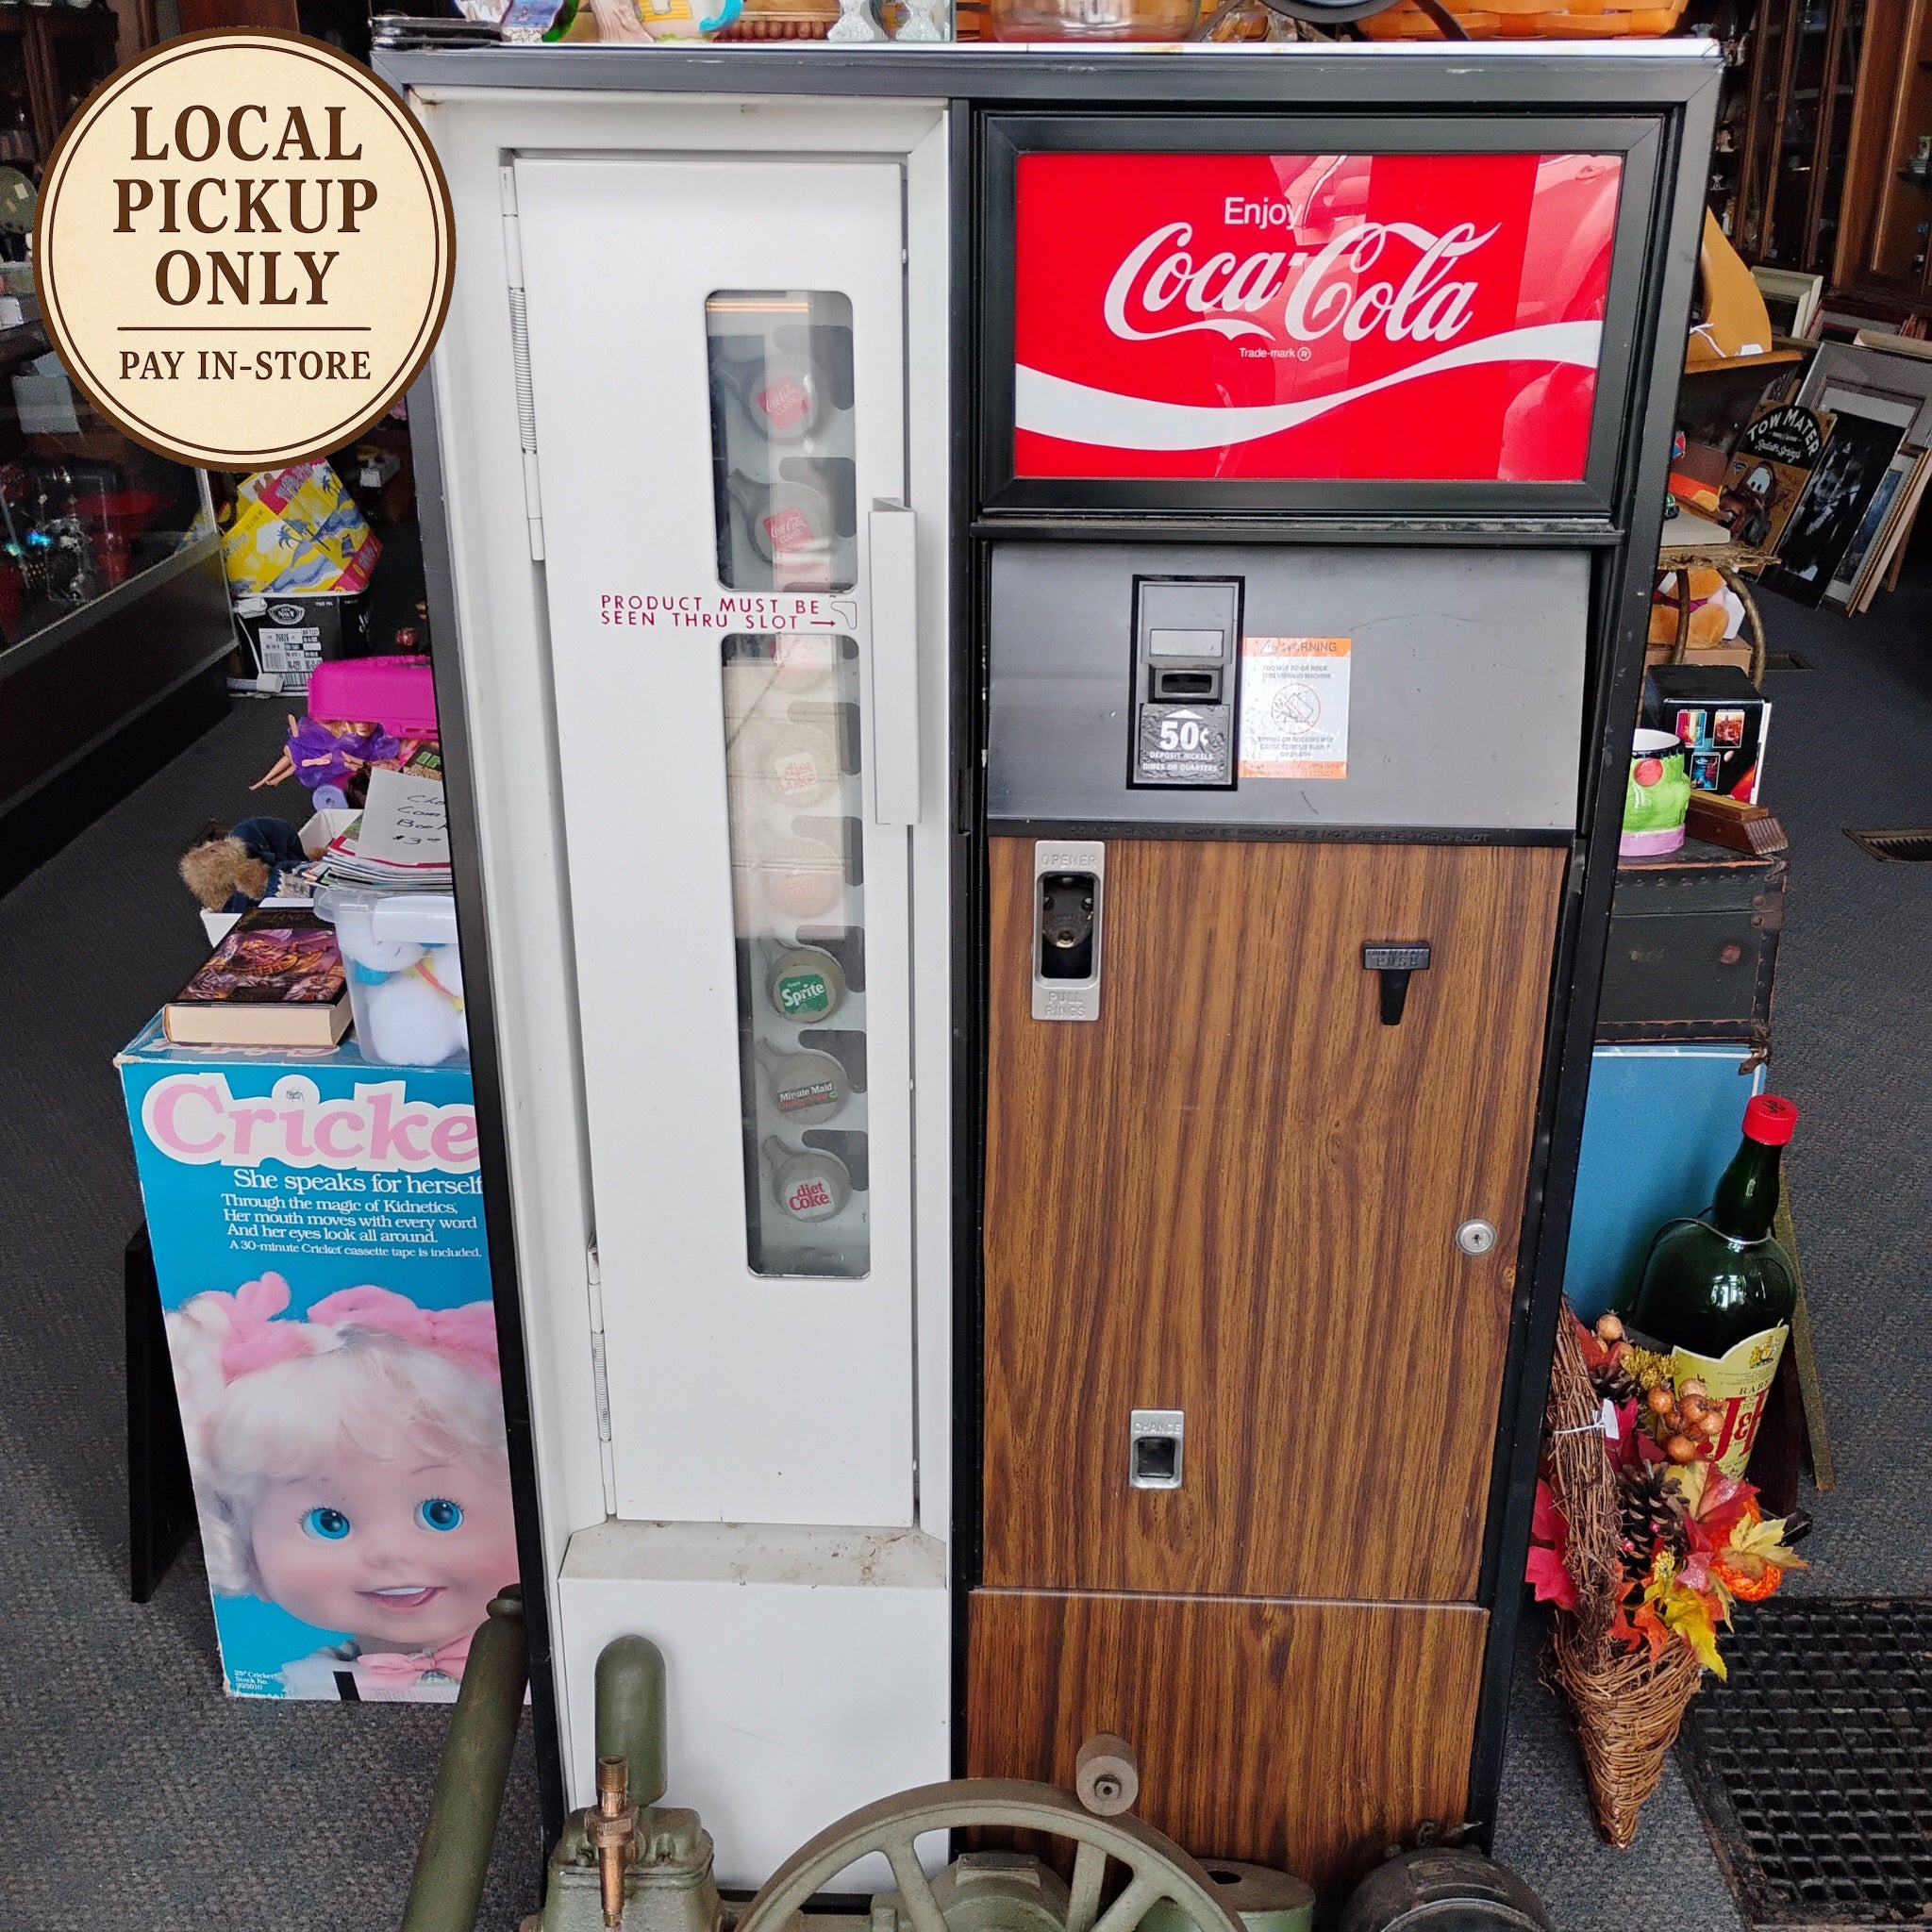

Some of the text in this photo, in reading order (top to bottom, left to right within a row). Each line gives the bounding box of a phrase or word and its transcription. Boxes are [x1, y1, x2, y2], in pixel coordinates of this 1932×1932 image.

[1224, 196, 1304, 230] Enjoy
[1104, 221, 1502, 341] Coca-Cola
[1747, 408, 1820, 458] TOW MATER
[601, 594, 819, 614] PRODUCT MUST BE
[601, 610, 798, 629] SEEN THRU SLOT
[1159, 721, 1209, 751] 50¢
[1149, 751, 1181, 759] DEPOSIT
[1179, 763, 1218, 773] QUARTERS
[1322, 830, 1349, 839] NOT
[1355, 830, 1407, 841] VISIBLE
[1455, 833, 1490, 842] SLOT
[1041, 853, 1097, 869] OPENER
[1376, 957, 1418, 967] PUSH
[781, 983, 825, 1008] Sprite
[1048, 991, 1083, 1005] PULL
[1044, 1006, 1086, 1018] RINGS
[779, 1082, 834, 1102] Minute Maid
[233, 1168, 483, 1195] She speaks for herself
[796, 1181, 825, 1197] diet
[220, 1192, 458, 1215] Through the magic of Kidnetics,
[789, 1193, 831, 1211] Coke
[223, 1208, 477, 1232] Her mouth moves with every word
[226, 1223, 439, 1243] And her eyes look all around.
[229, 1239, 483, 1259] A 30-minute Cricket cassette tape is included.
[1134, 1422, 1182, 1434] CHANGE
